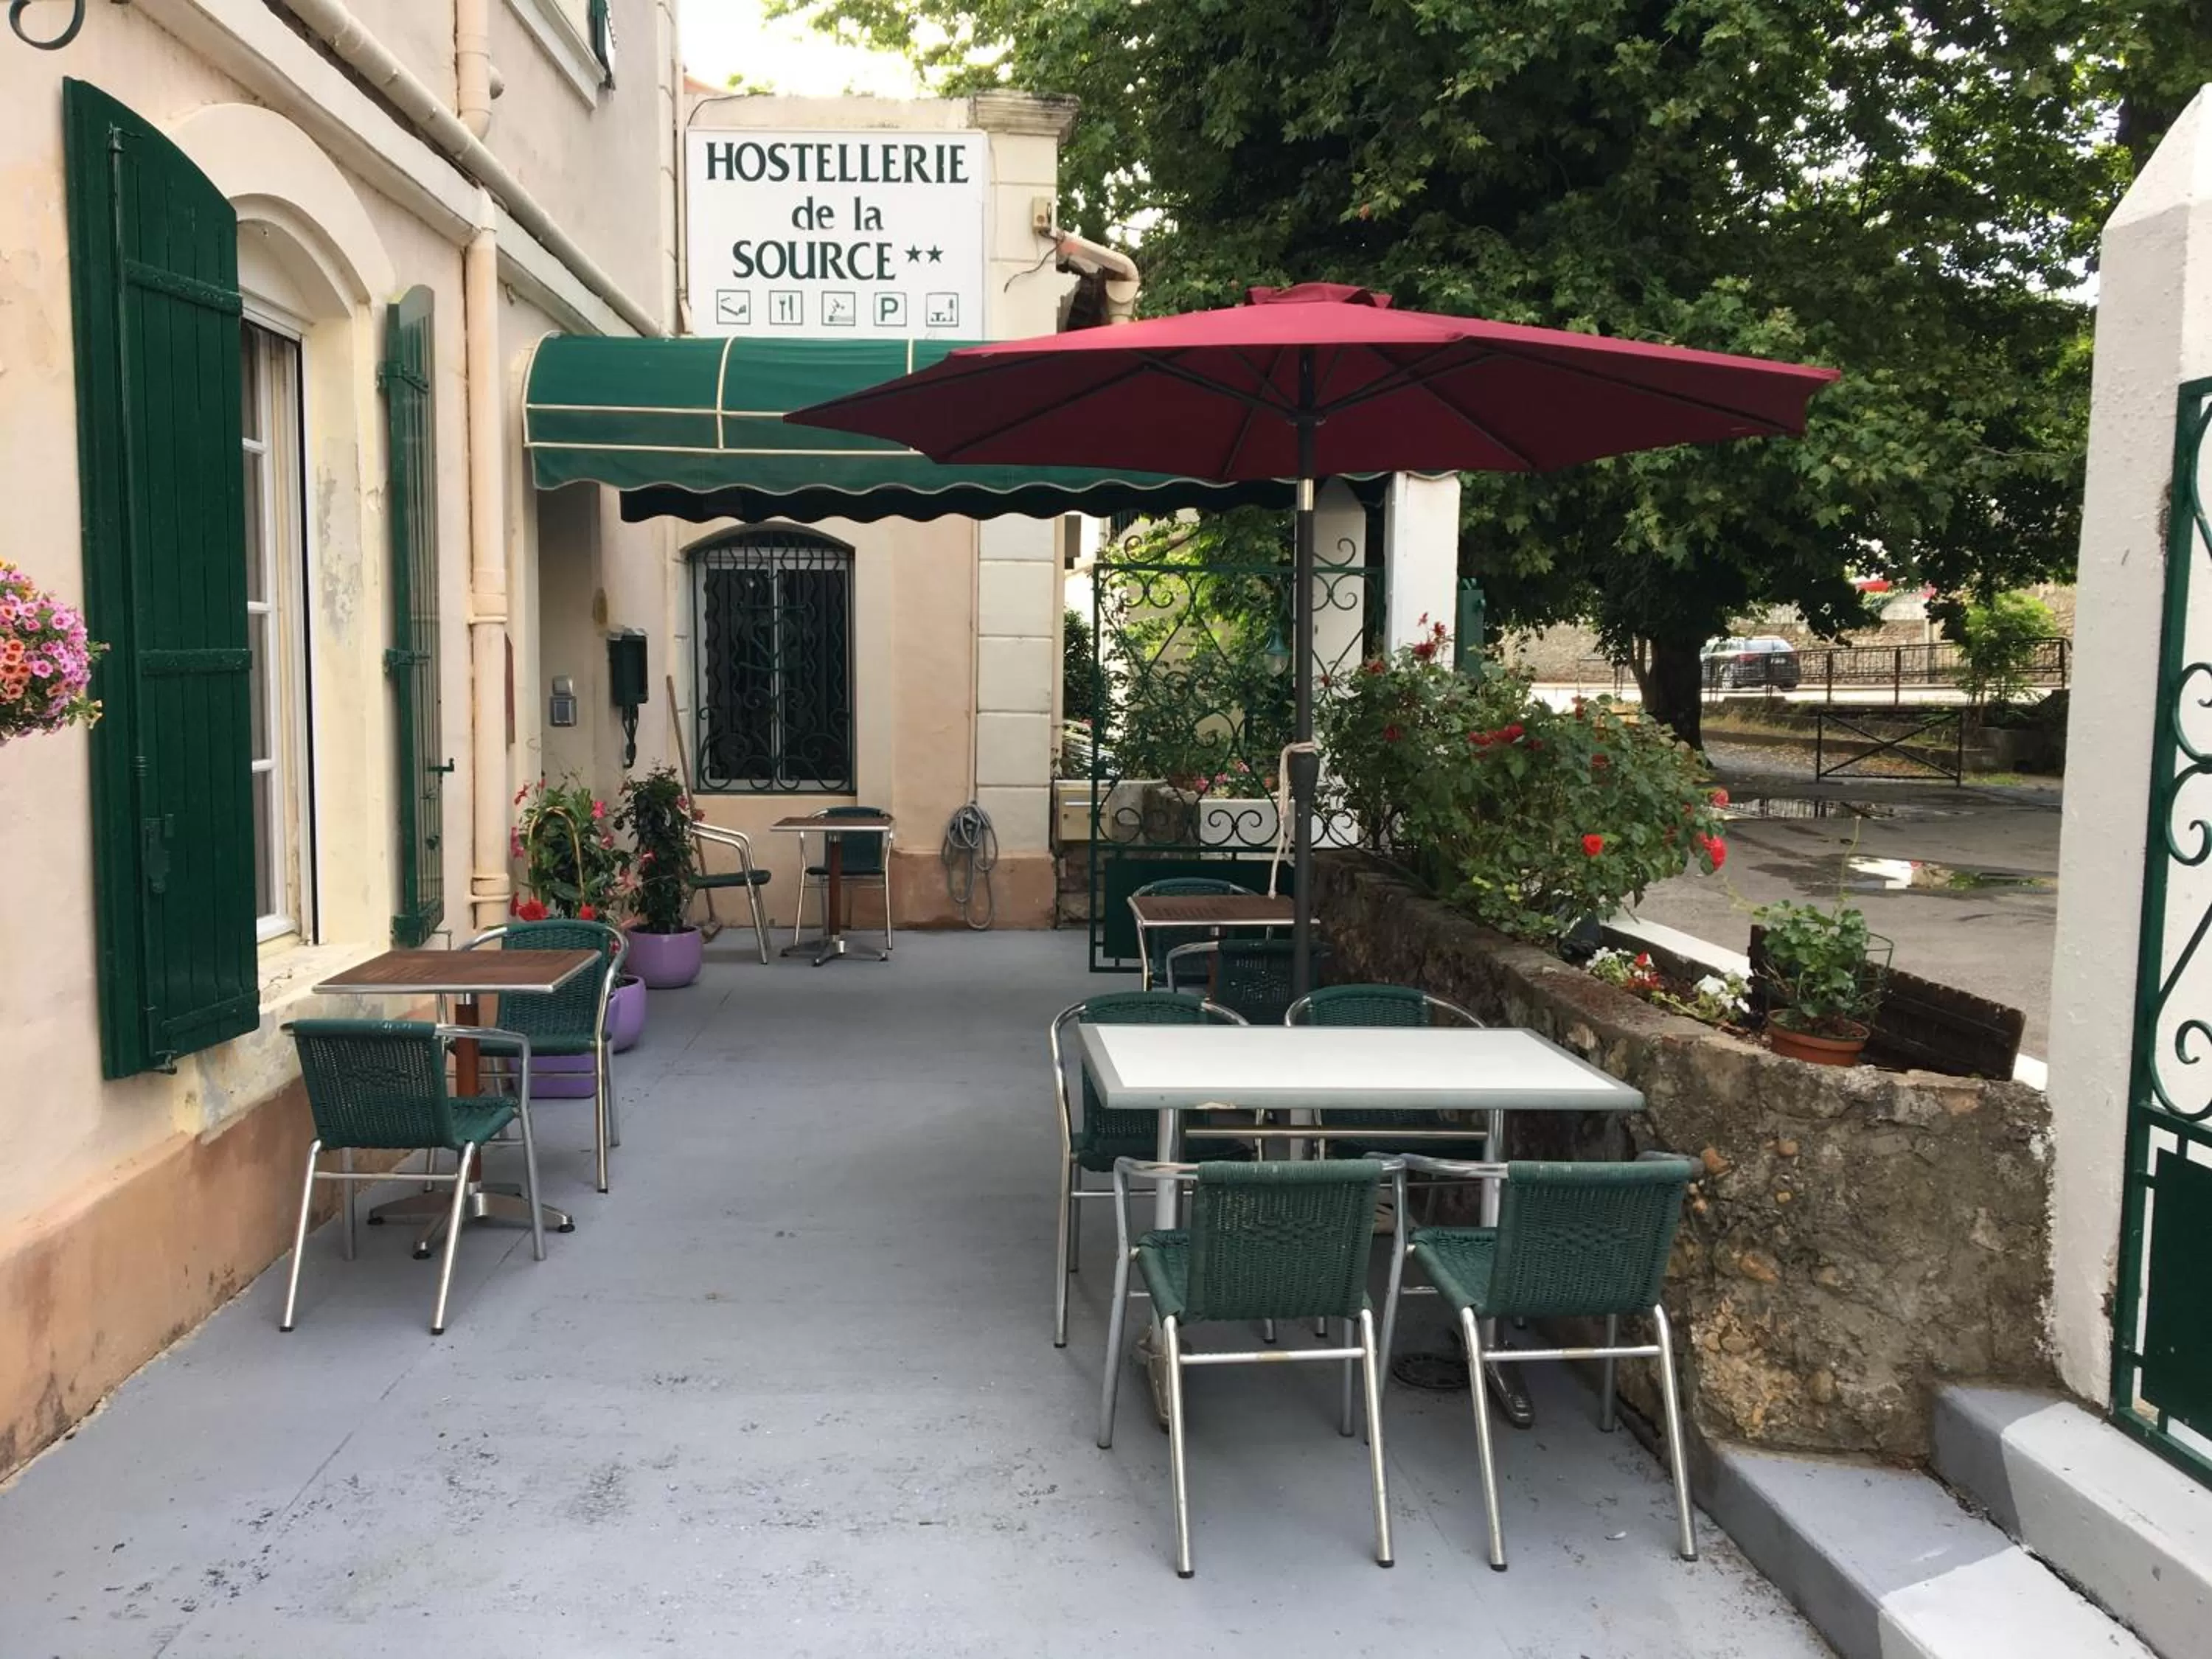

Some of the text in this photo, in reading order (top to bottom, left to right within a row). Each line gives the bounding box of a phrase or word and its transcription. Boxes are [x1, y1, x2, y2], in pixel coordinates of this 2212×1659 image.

[706, 142, 970, 184] HOSTELLERIE
[791, 195, 884, 231] de la
[731, 240, 897, 281] SOURCE
[880, 296, 900, 321] P
